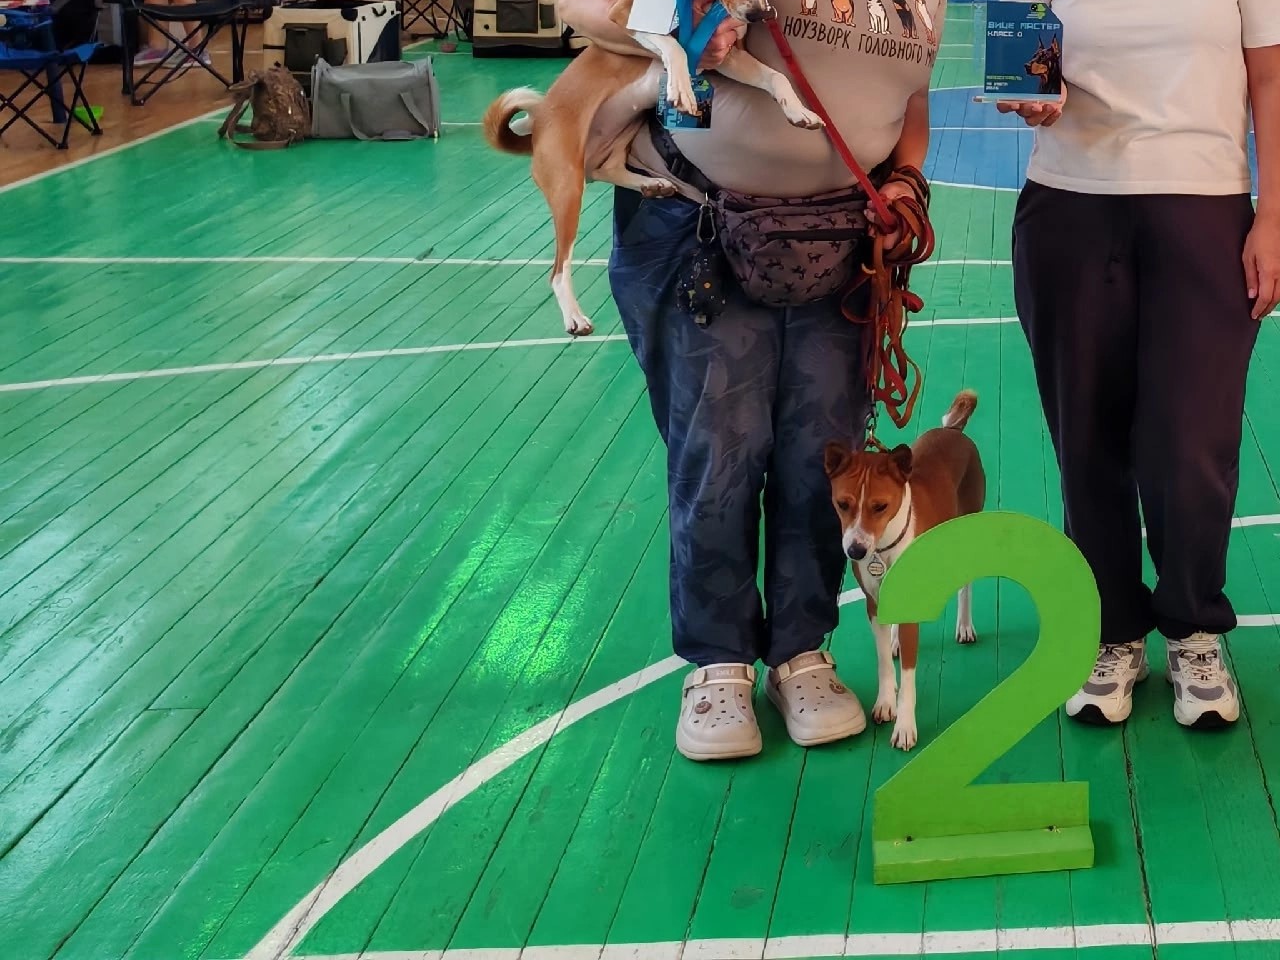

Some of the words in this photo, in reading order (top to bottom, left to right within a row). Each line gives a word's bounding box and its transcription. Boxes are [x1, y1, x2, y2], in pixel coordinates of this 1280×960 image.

[784, 16, 851, 50] НОУЗВОРК
[858, 34, 923, 64] ГОЛОВНОГО
[988, 21, 1015, 30] ВИЦЕ
[1020, 22, 1061, 30] МАСТЕР
[875, 511, 1101, 840] 2
